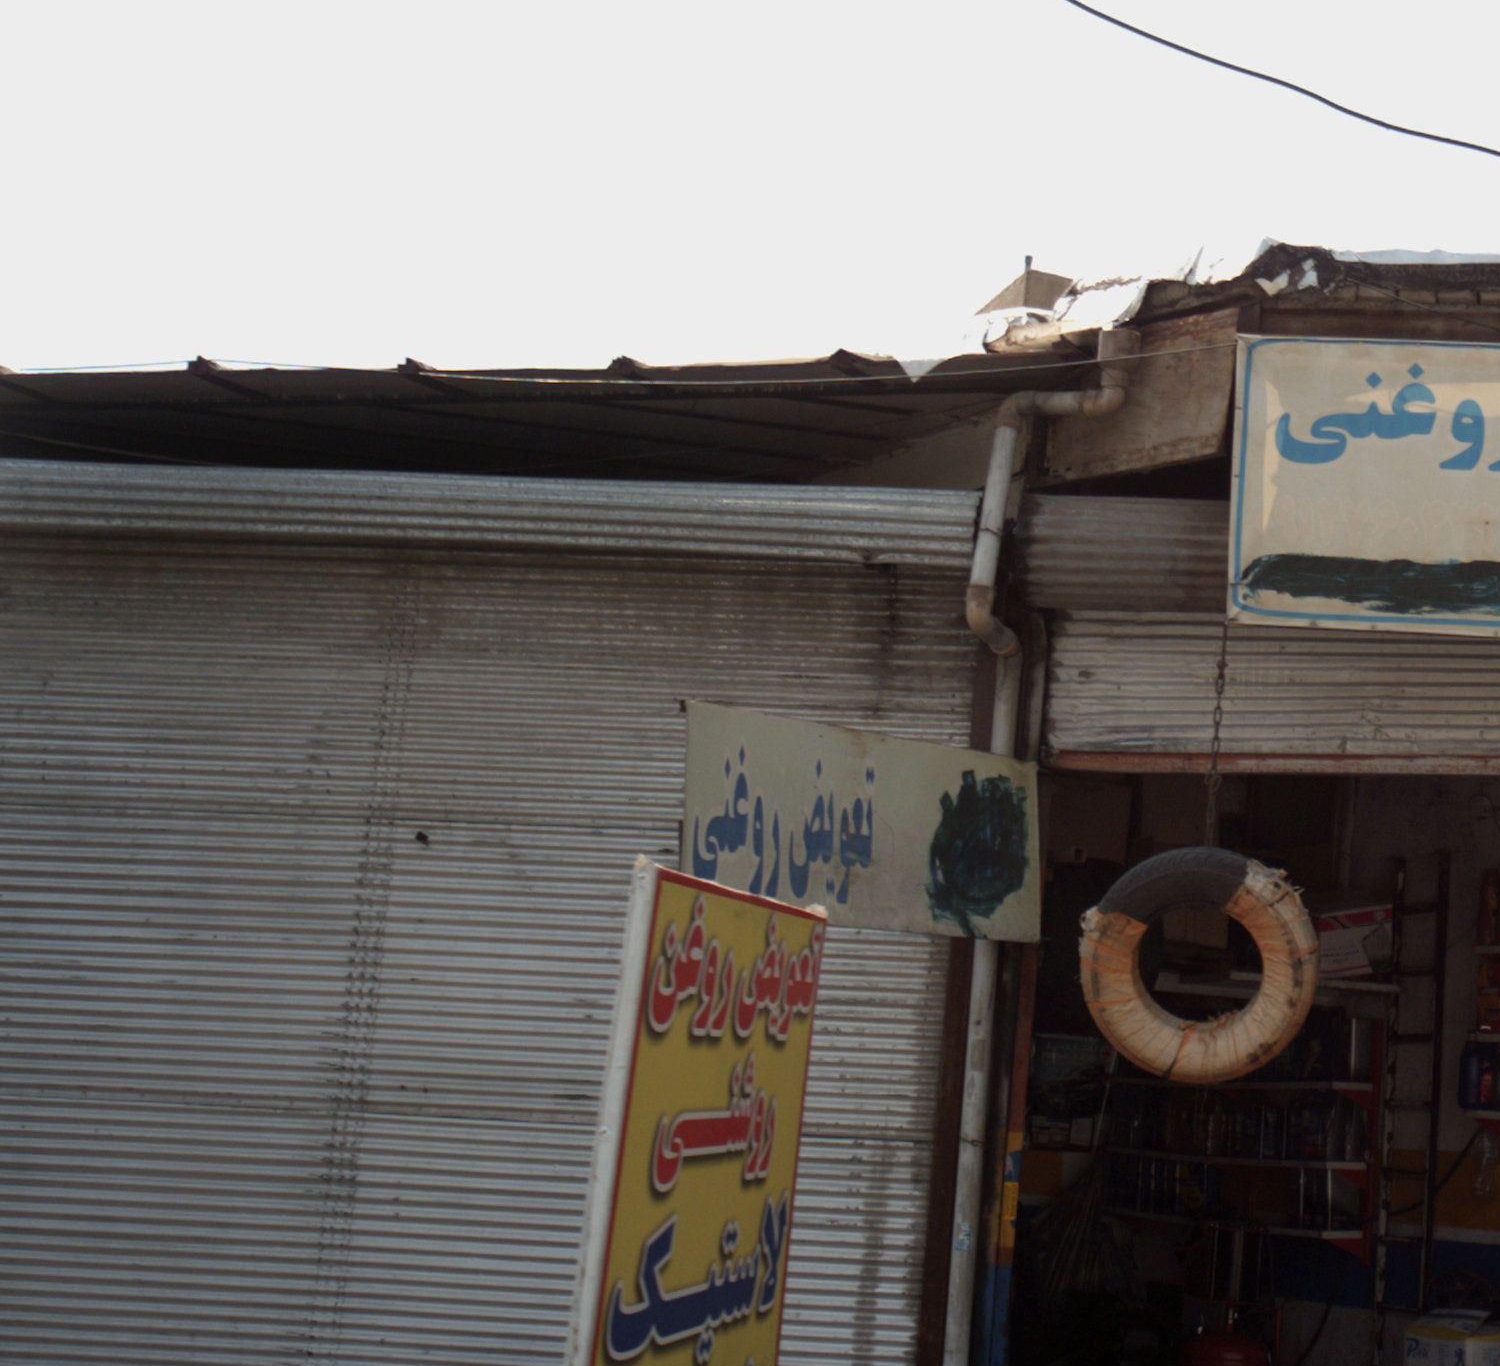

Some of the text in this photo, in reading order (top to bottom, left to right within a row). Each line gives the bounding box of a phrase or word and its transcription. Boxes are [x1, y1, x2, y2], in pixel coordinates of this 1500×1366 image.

[692, 744, 874, 905] تعویض روغنی
[648, 890, 826, 1043] تعویض روغن
[605, 1189, 790, 1363] لاستیک
